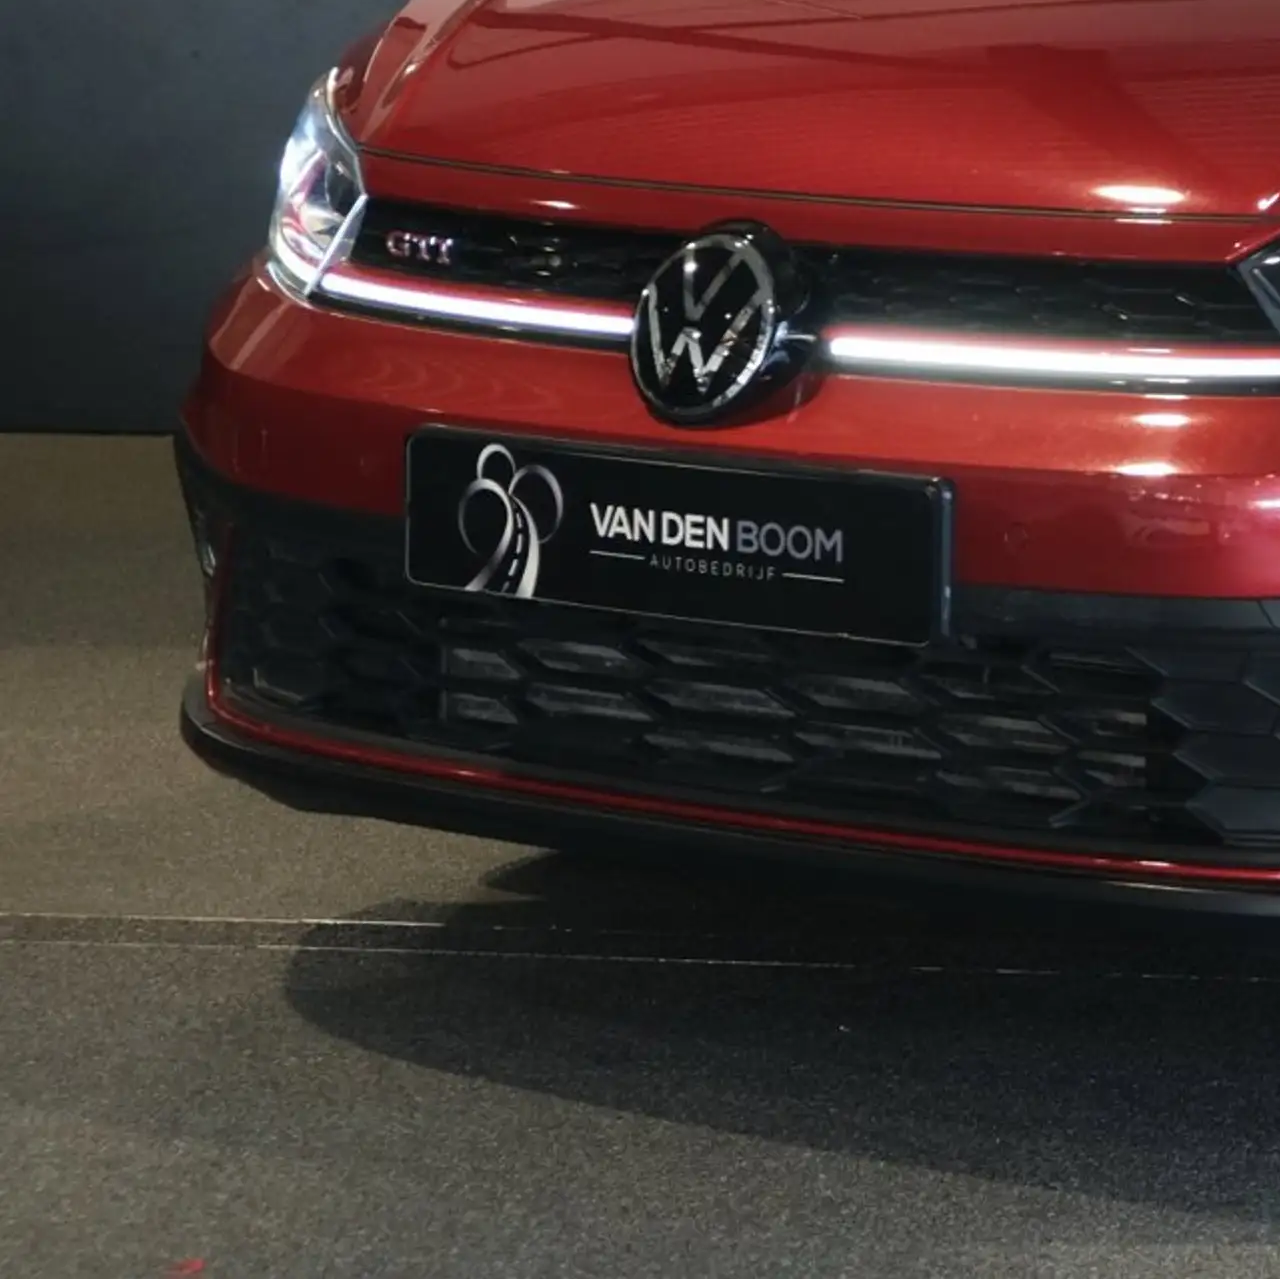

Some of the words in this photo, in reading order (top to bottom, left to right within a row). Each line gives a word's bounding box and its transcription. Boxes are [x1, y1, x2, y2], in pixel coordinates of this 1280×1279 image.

[385, 229, 454, 265] GTI
[590, 502, 656, 544] VAN
[661, 511, 730, 552] DEN
[736, 520, 844, 562] BOOM
[649, 553, 776, 581] AUTOBEDRIJF
